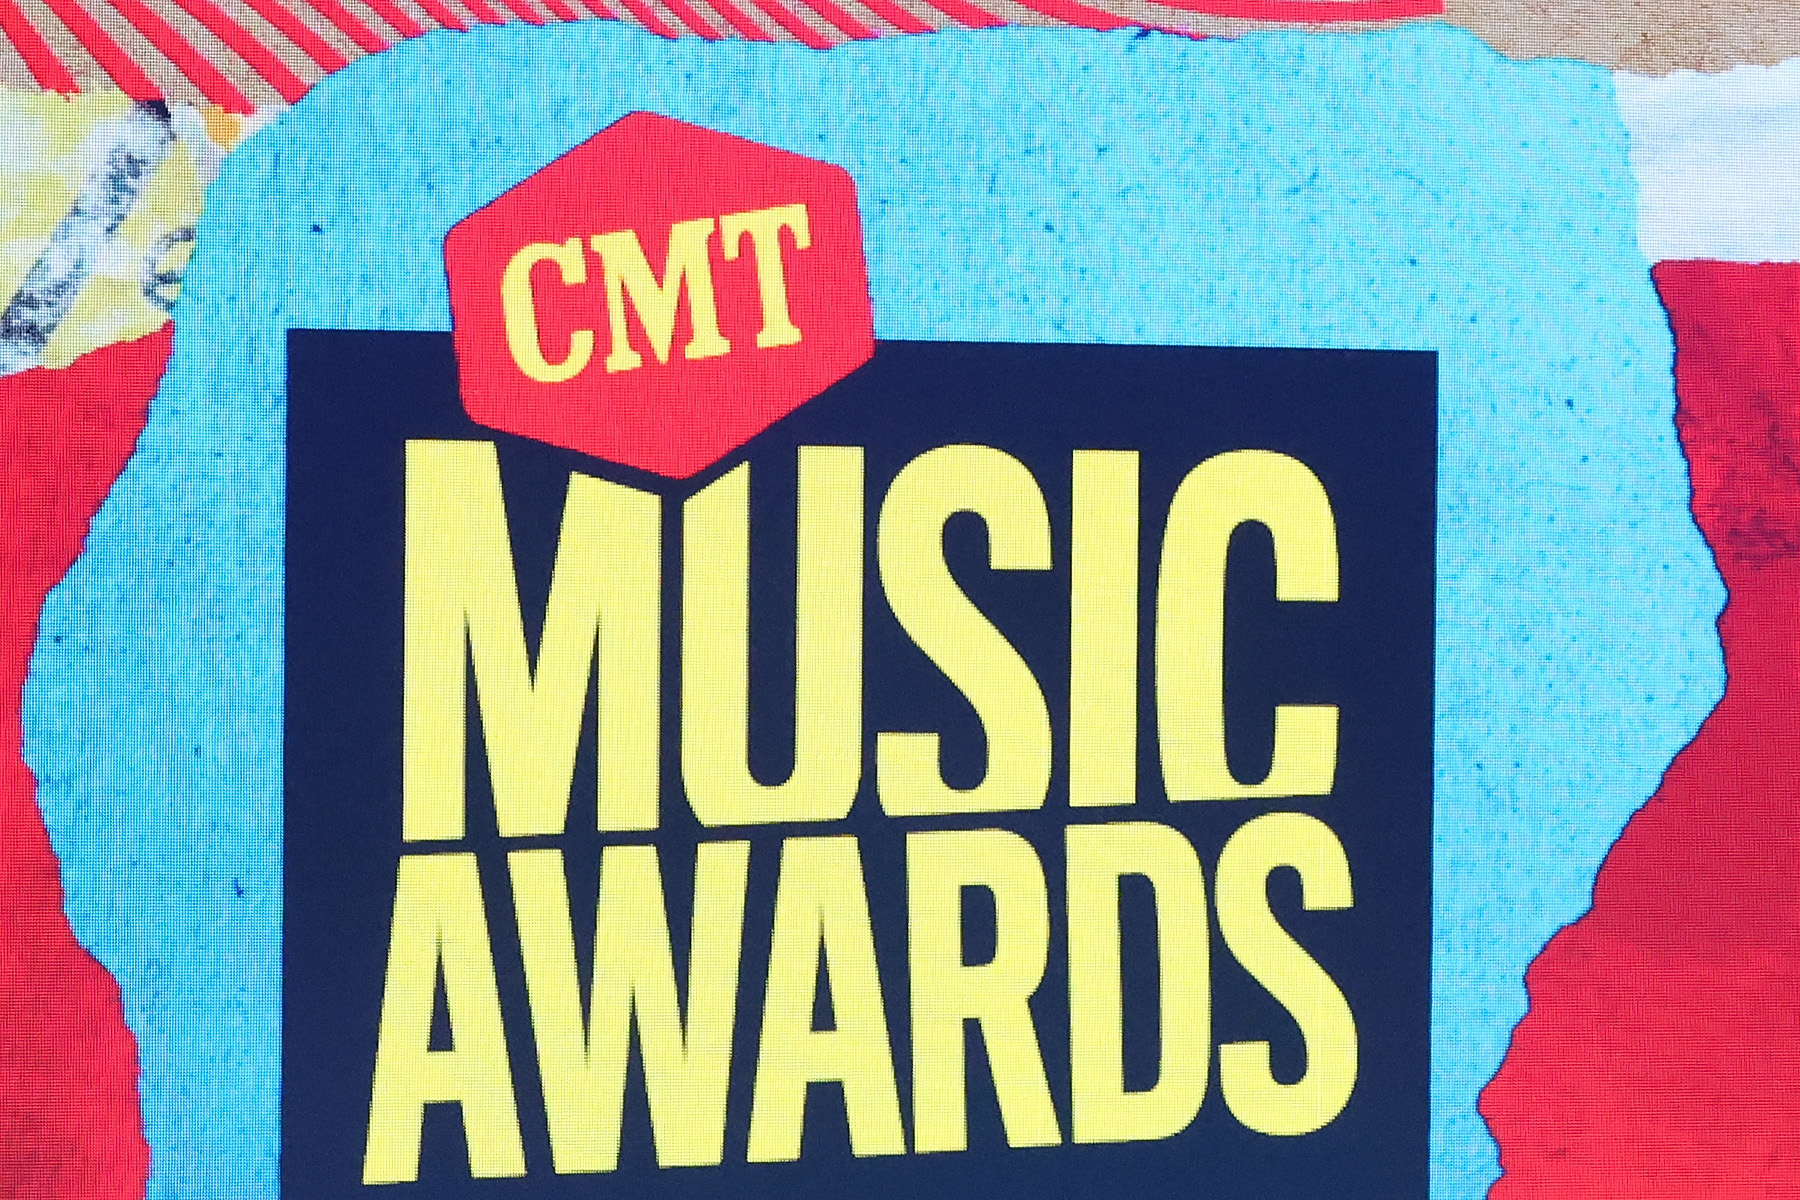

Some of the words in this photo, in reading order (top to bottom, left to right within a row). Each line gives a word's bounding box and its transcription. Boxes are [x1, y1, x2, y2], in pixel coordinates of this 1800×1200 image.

[501, 204, 810, 382] CMT
[403, 440, 1339, 842] MUSIC
[363, 813, 1357, 1185] AWARDS
